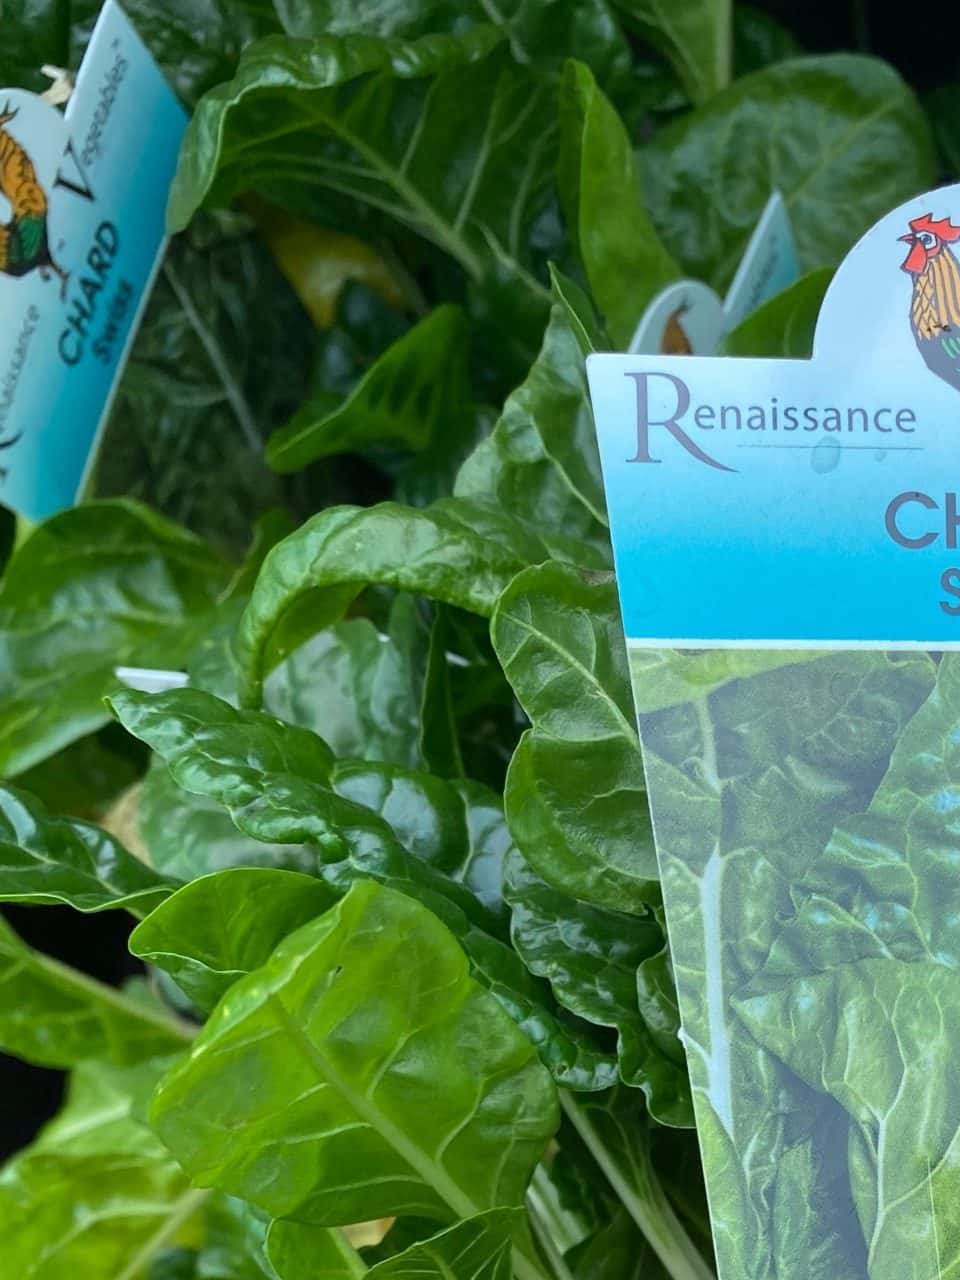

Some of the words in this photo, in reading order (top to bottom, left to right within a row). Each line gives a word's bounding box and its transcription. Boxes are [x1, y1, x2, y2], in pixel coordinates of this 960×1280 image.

[52, 54, 128, 201] Vegetables
[58, 221, 119, 366] CHARD
[92, 280, 133, 364] Swiss
[624, 371, 917, 473] Renaissance
